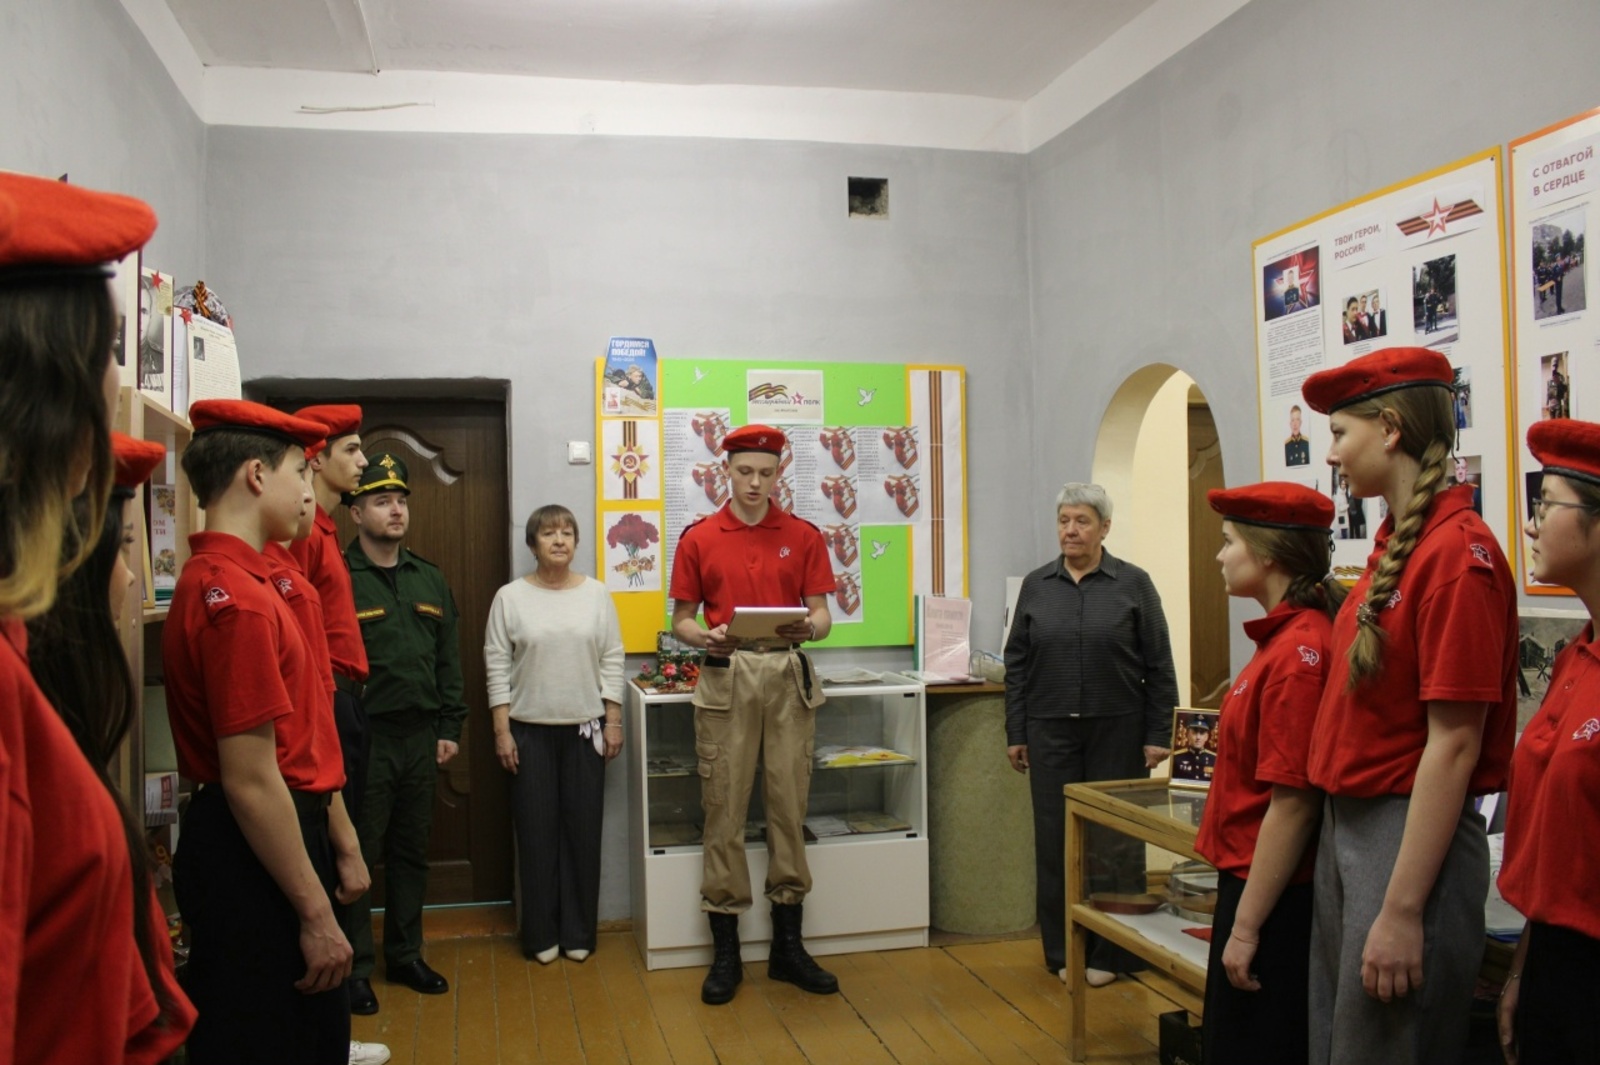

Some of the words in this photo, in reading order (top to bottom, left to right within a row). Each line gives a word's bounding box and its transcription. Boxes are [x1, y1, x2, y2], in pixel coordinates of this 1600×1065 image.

[1532, 167, 1540, 178] С
[1542, 145, 1593, 175] ОТВАГОЙ
[1533, 185, 1540, 196] В
[1543, 169, 1586, 193] СЕРДЦЕ
[1334, 233, 1353, 246] ТВОИ
[1334, 242, 1366, 260] РОССИЯ!
[611, 340, 650, 349] ГОРДИМСЯ
[611, 348, 646, 357] ПОБЕДОЙ!
